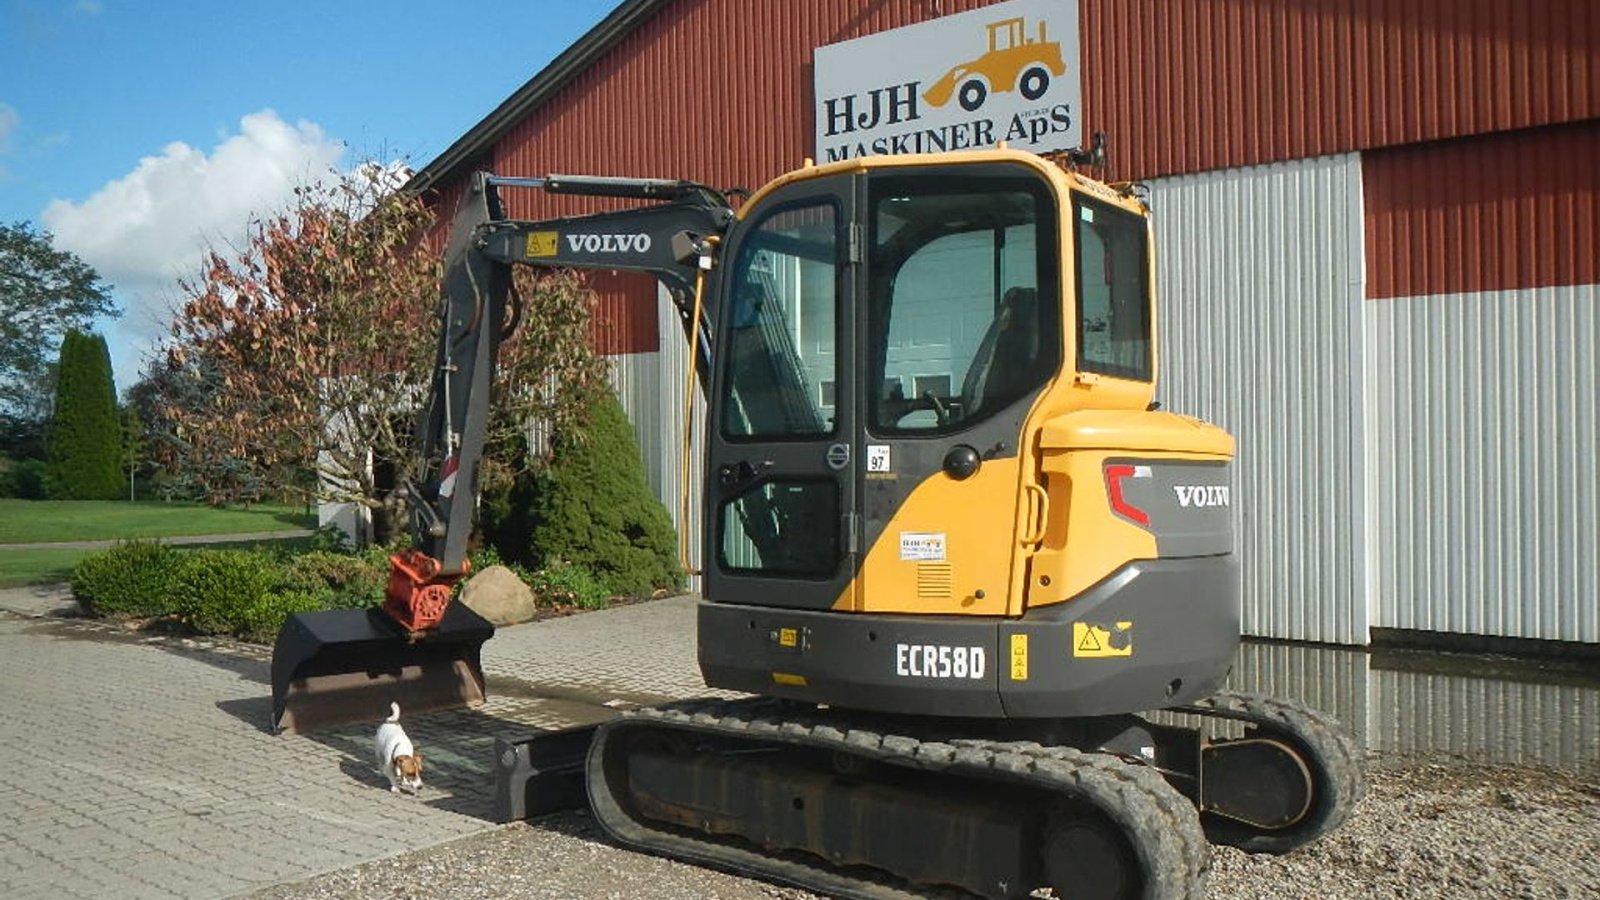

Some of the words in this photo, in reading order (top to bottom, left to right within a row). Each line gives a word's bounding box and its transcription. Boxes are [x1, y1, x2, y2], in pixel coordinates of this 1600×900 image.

[824, 81, 921, 136] HJH
[1006, 104, 1071, 144] ApS
[566, 233, 651, 253] VOLVO
[871, 456, 884, 470] 97
[1173, 485, 1229, 507] VOLV
[896, 644, 985, 679] ECR58D
